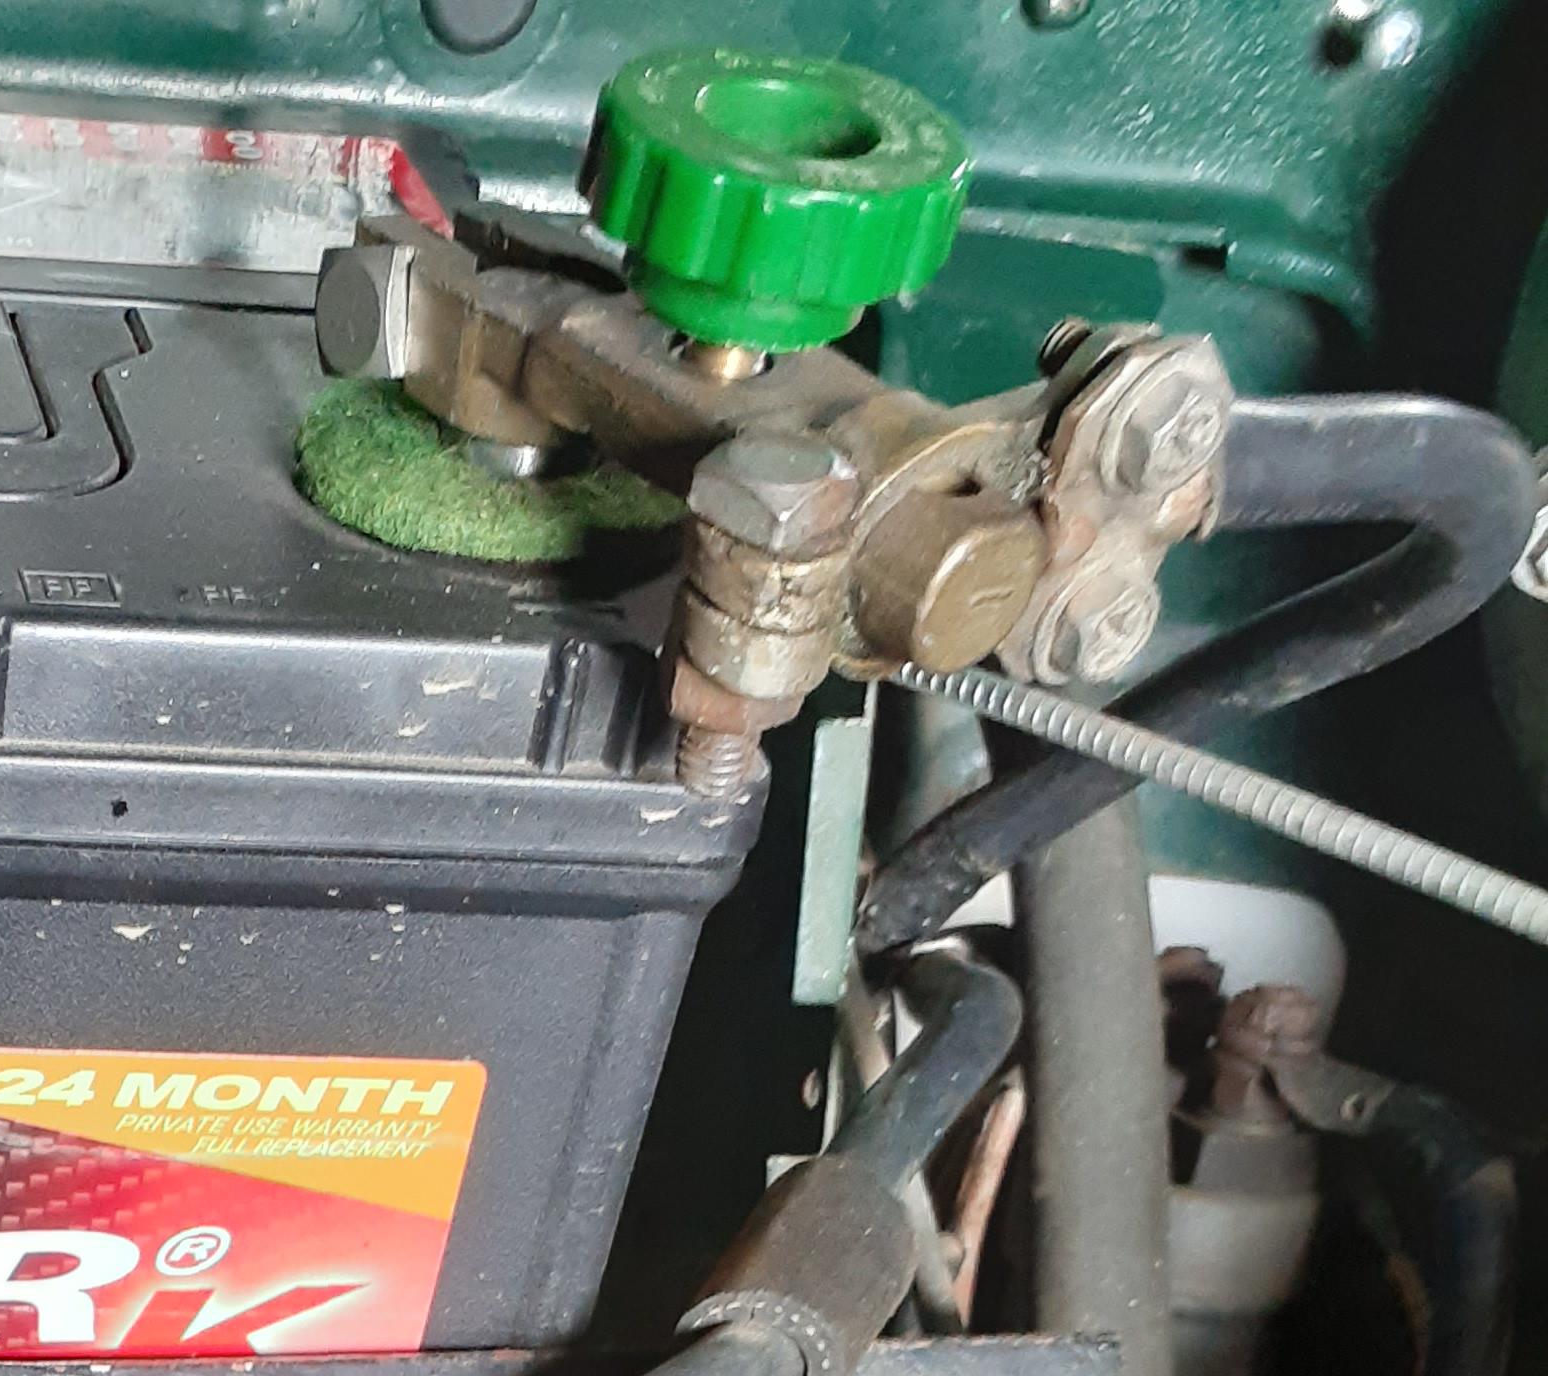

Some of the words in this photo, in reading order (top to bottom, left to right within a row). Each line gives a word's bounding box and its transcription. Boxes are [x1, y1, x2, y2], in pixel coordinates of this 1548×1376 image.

[113, 1072, 455, 1116] MONTH
[116, 1112, 233, 1134] PRIVATE
[233, 1116, 290, 1137] USE
[292, 1117, 444, 1140] WARRANTY
[191, 1136, 251, 1156] FULL
[252, 1137, 432, 1160] REPLACEMENT
